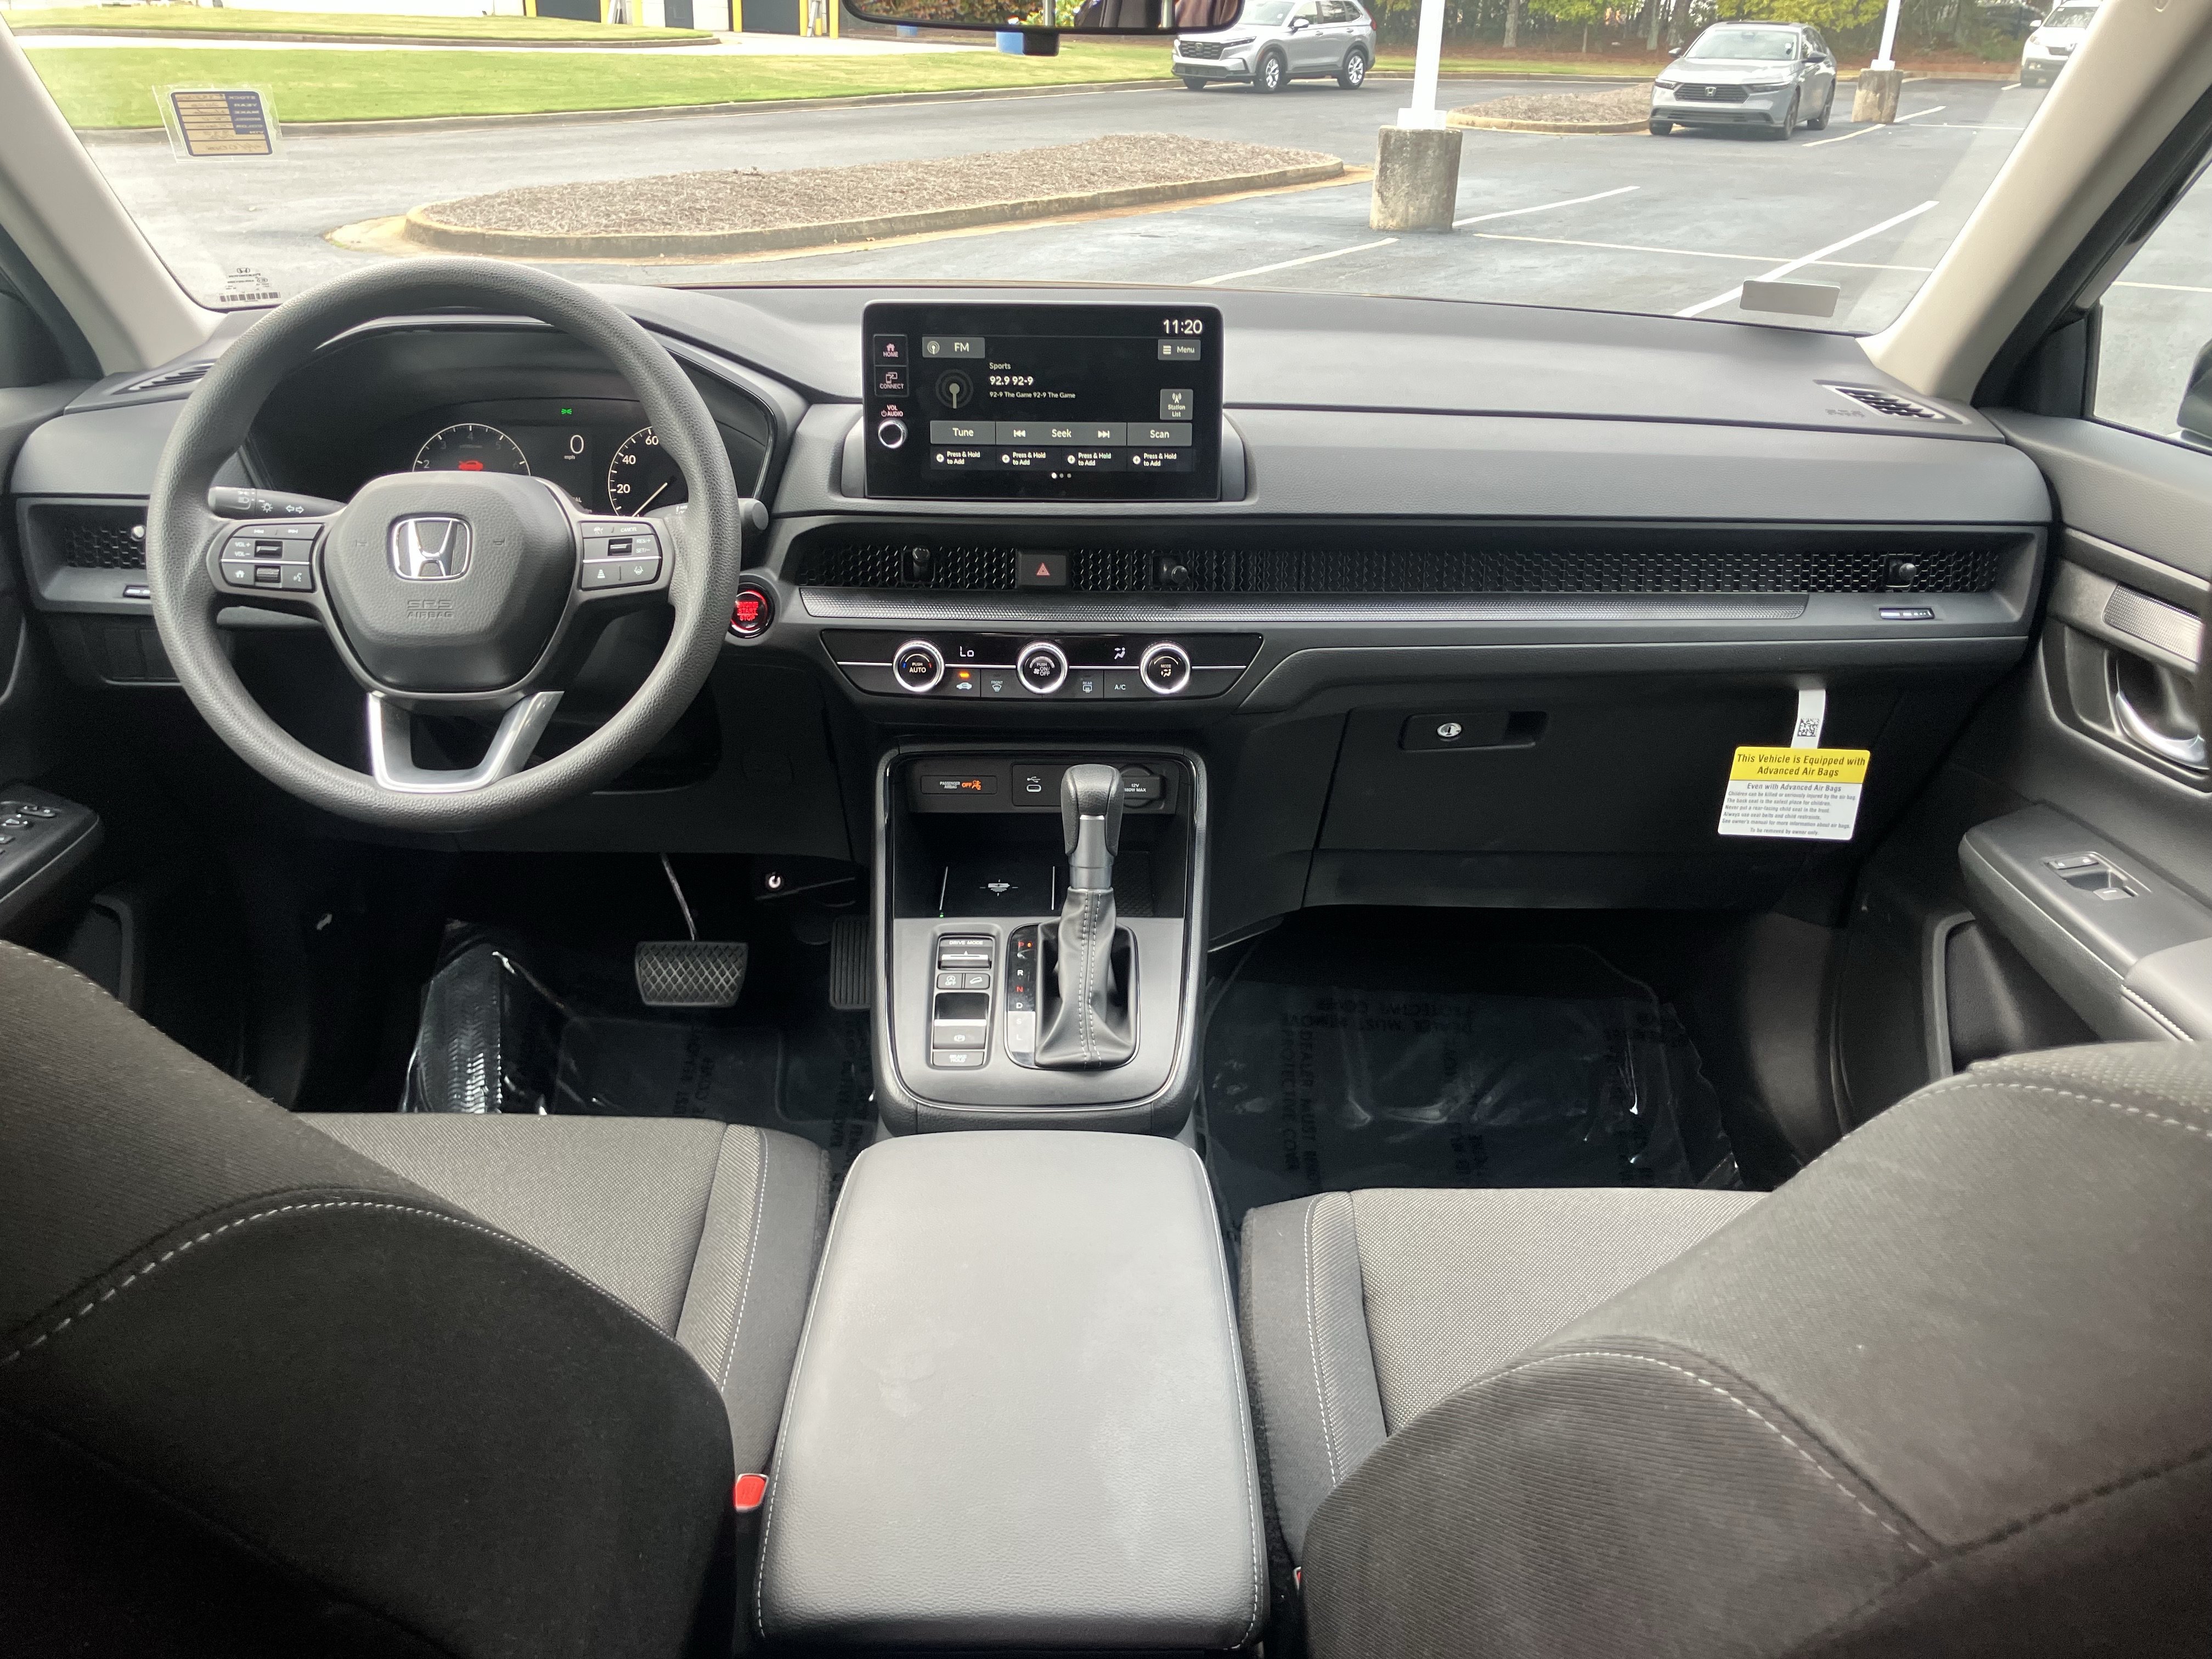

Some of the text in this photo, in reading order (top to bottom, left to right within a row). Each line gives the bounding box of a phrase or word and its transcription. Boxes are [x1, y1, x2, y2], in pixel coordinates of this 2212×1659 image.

[1163, 319, 1203, 334] 11:20
[954, 342, 969, 352] FM
[989, 362, 1011, 370] Sports
[989, 376, 1034, 385] 92.9 92-9
[952, 427, 974, 437] Tune
[1052, 429, 1071, 437] Seek
[1150, 430, 1170, 438] Scan
[570, 435, 584, 454] 0
[645, 436, 658, 445] 60
[424, 460, 430, 469] 2
[622, 455, 636, 465] 40
[617, 484, 630, 494] 20
[407, 599, 453, 609] SRS
[960, 646, 974, 657] Lo
[1737, 754, 1755, 763] This
[1759, 754, 1790, 763] Vehicle
[1803, 756, 1844, 766] Equipped
[1847, 757, 1865, 765] with
[1757, 766, 1839, 777] Advanced Air Bags
